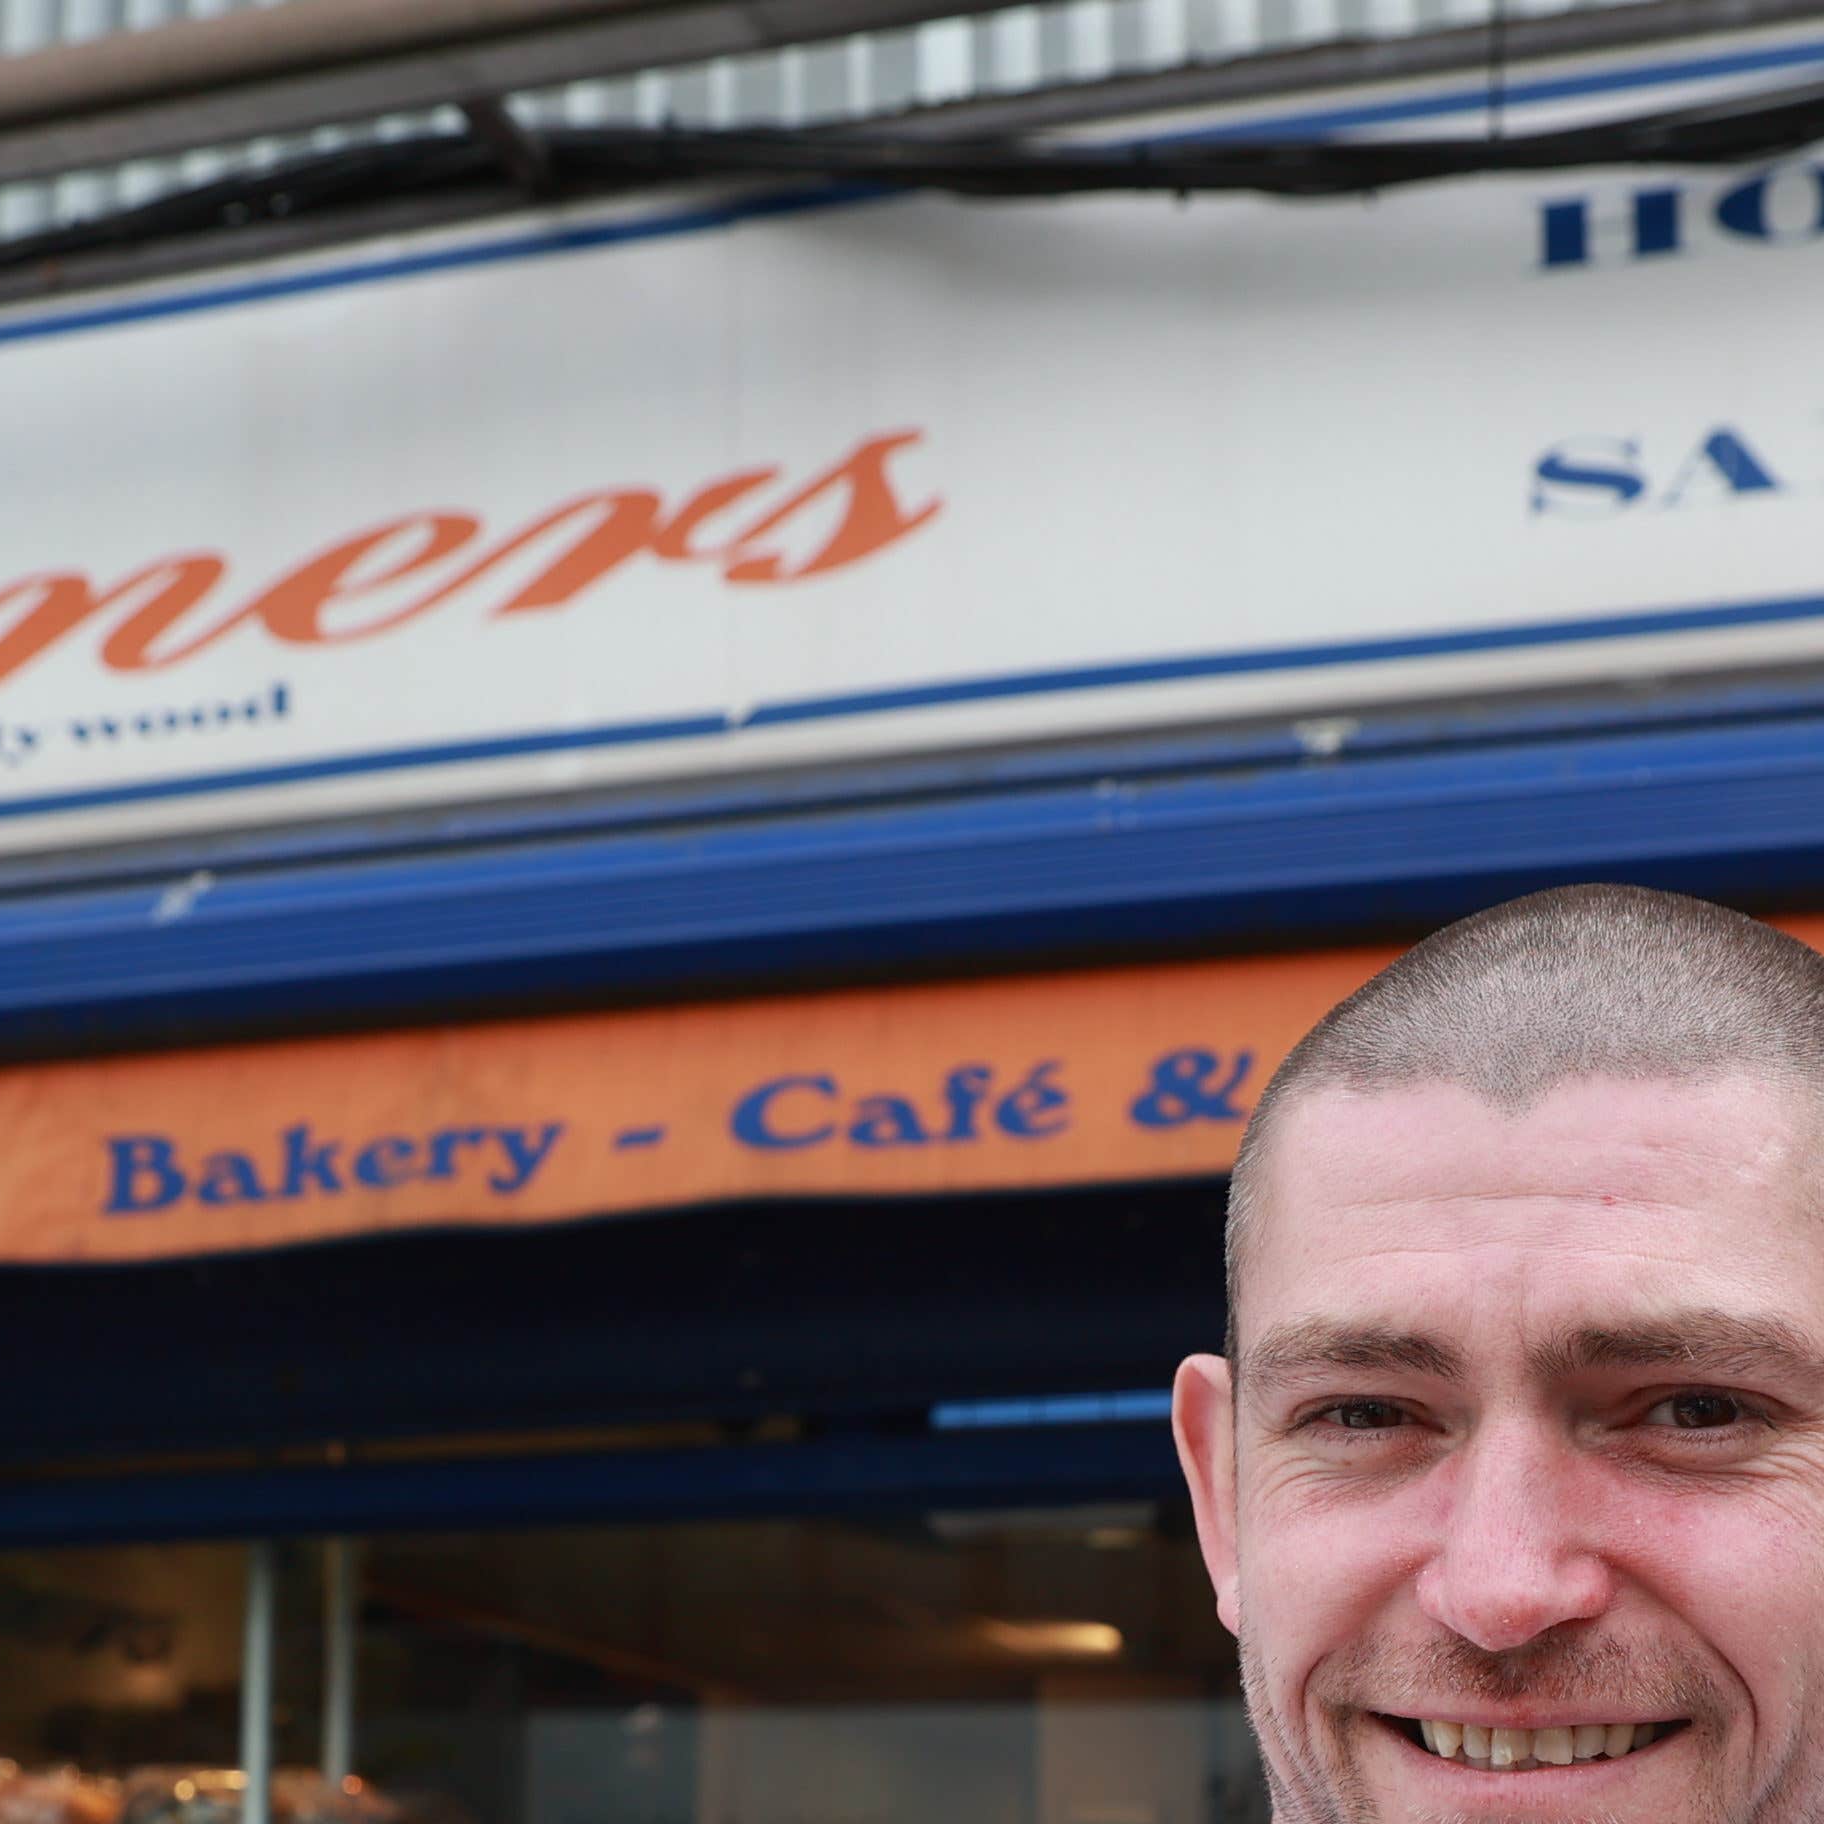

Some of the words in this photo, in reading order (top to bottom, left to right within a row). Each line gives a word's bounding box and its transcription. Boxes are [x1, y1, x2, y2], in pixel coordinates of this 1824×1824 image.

[100, 1120, 567, 1218] Bakery
[728, 1057, 1072, 1153] Café
[1128, 1045, 1255, 1130] &
